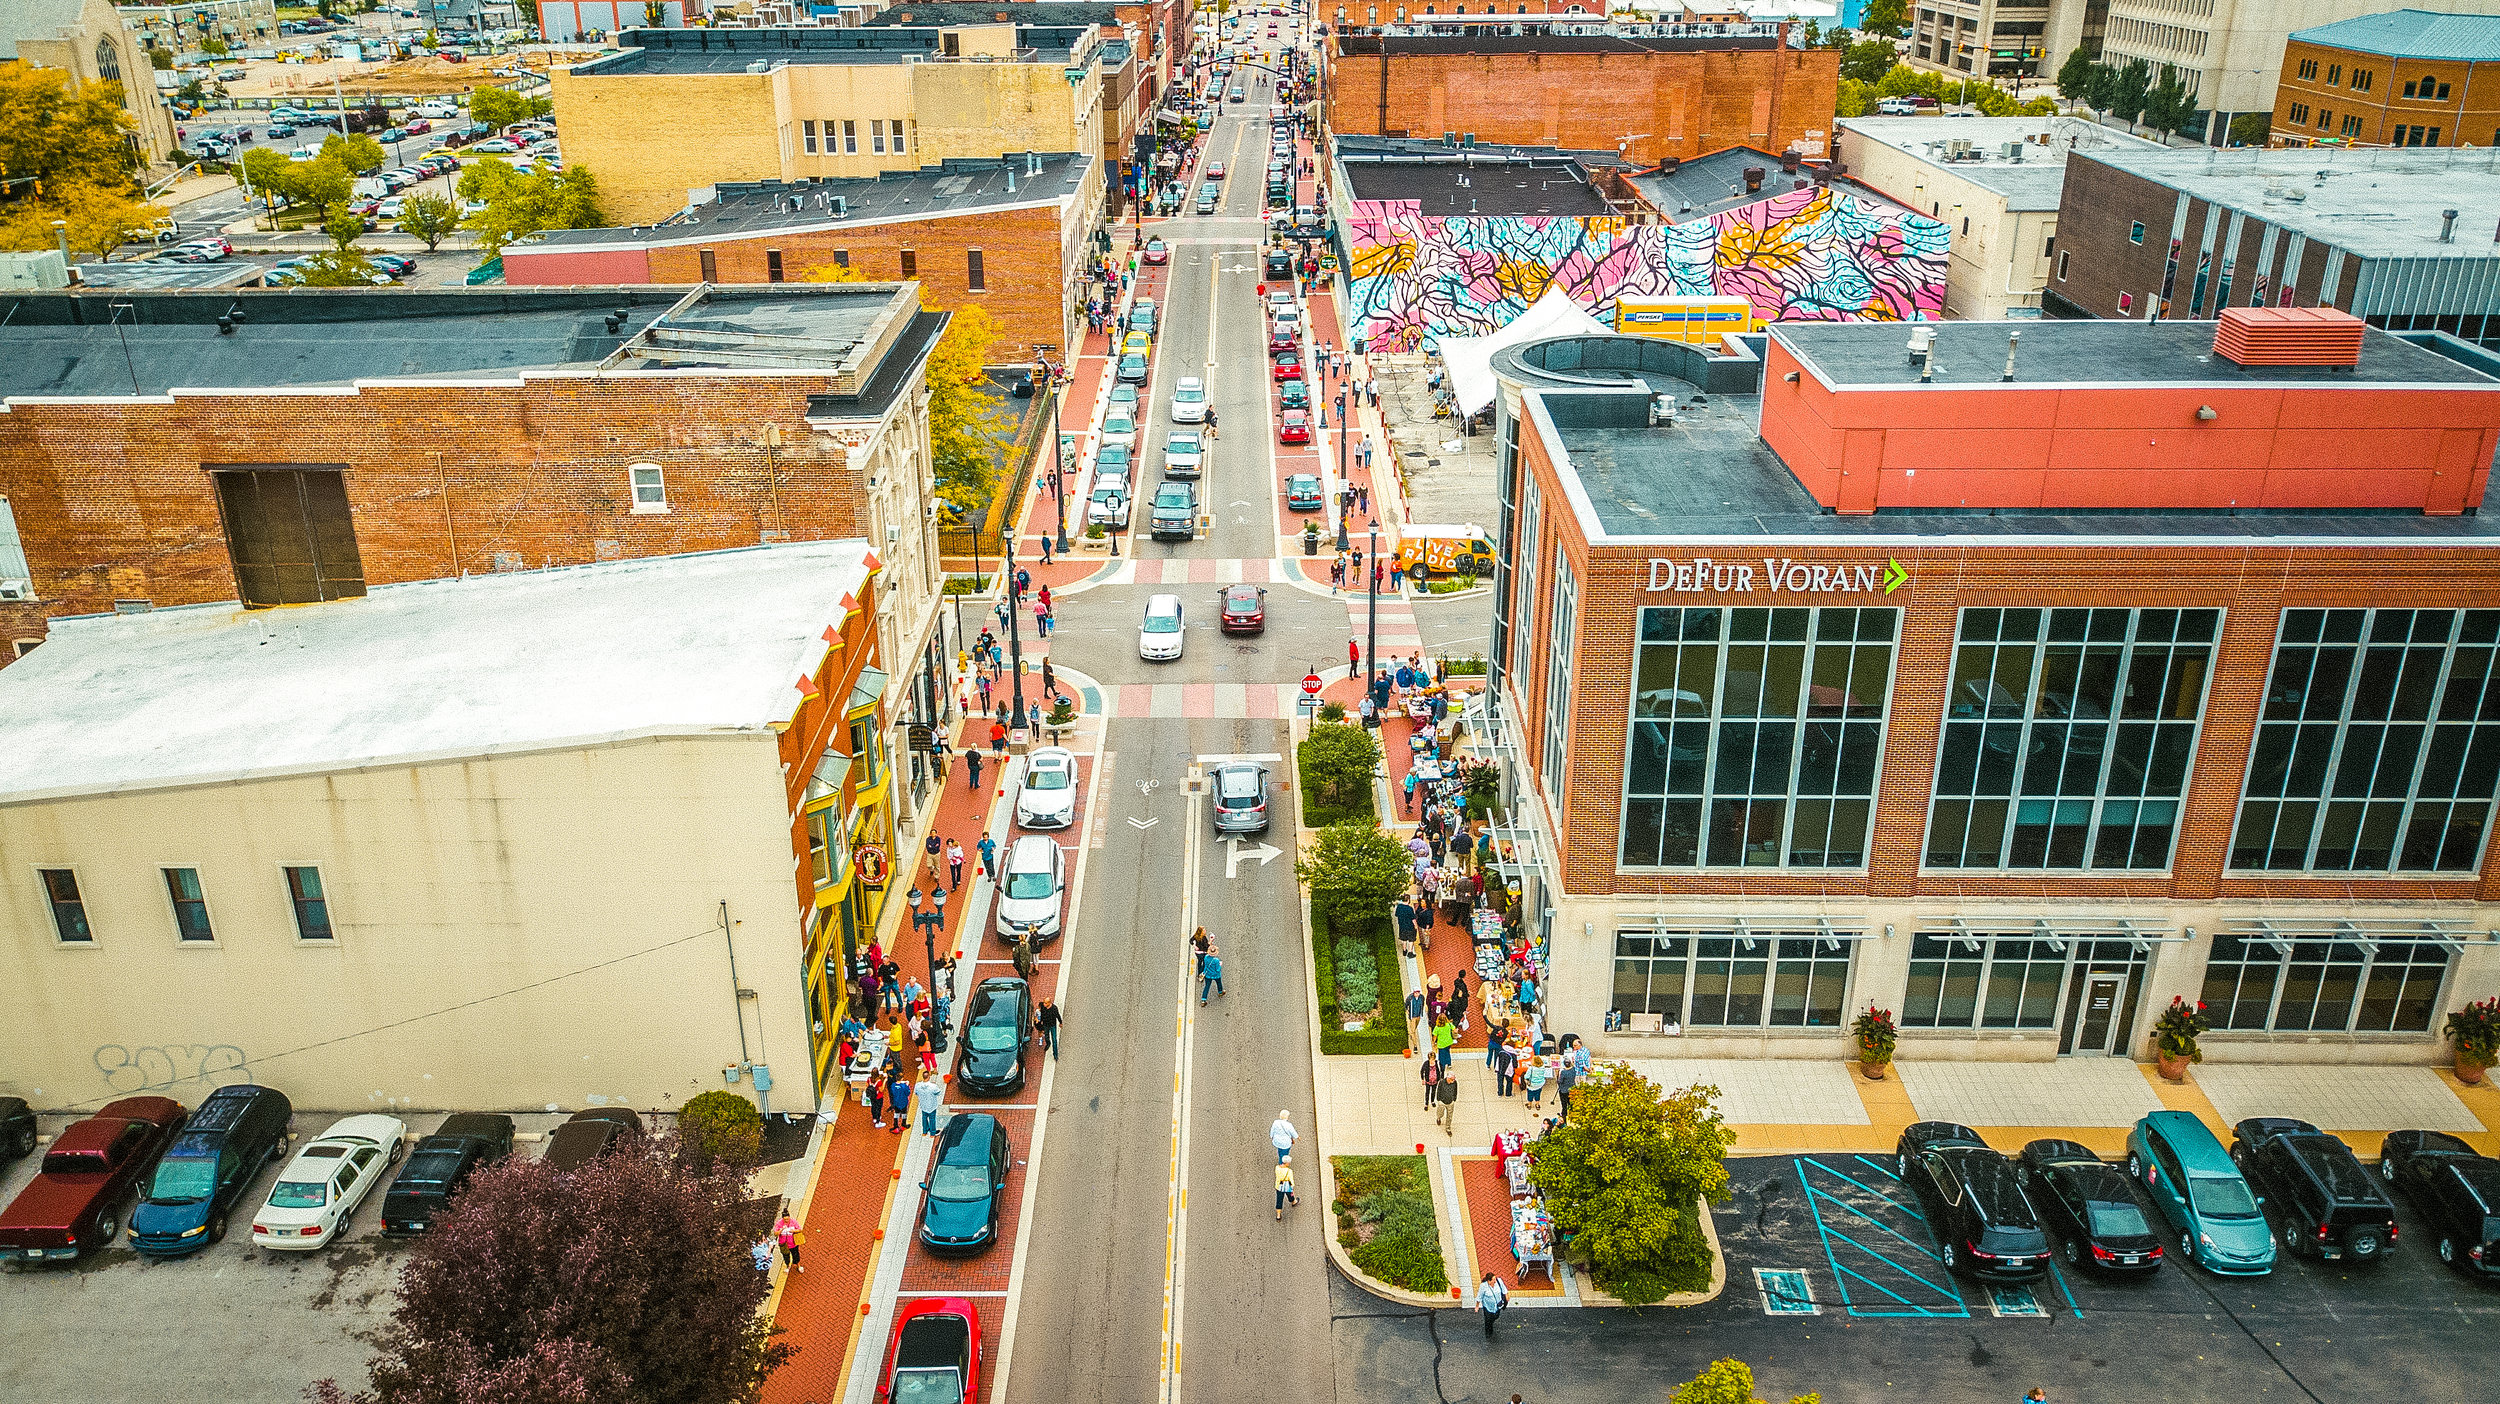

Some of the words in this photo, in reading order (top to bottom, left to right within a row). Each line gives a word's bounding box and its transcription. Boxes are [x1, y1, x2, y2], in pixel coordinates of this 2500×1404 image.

[1415, 538, 1453, 557] LIVE
[1405, 548, 1456, 568] RADIO
[1302, 681, 1321, 689] STOP
